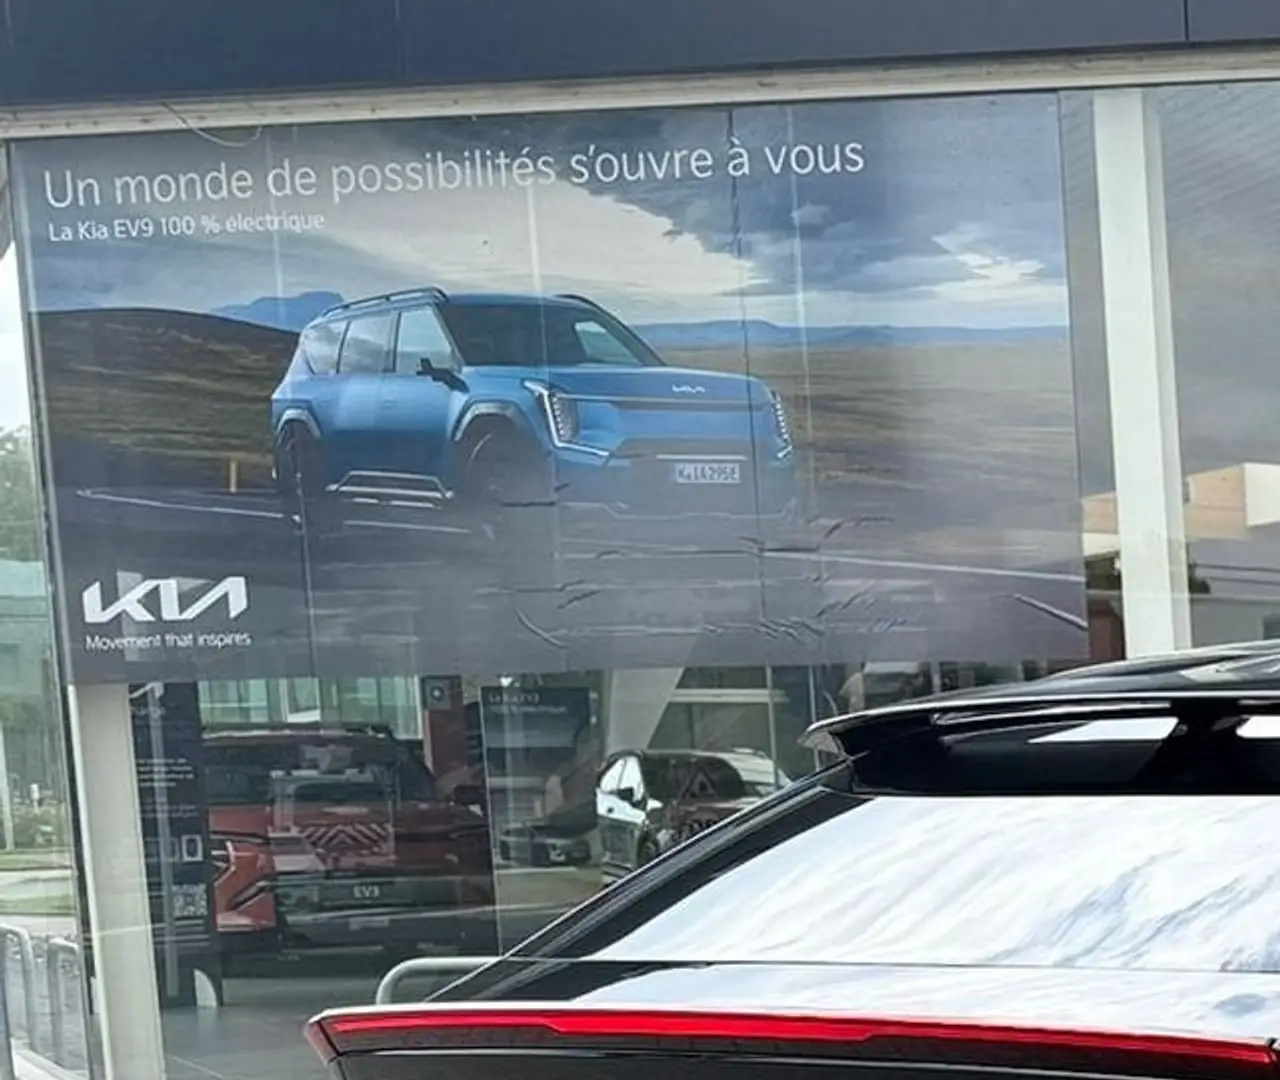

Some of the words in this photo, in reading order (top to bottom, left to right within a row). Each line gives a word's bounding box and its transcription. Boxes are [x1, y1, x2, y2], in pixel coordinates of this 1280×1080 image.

[44, 169, 101, 208] Un
[114, 162, 254, 204] monde
[267, 157, 318, 197] de
[331, 146, 556, 205] possibilités
[570, 144, 714, 185] s'ouvre
[727, 136, 750, 177] à
[765, 140, 865, 174] vous
[49, 223, 73, 241] La
[78, 220, 108, 240] Kia
[113, 218, 153, 238] EV9
[160, 215, 195, 236] 100
[201, 214, 220, 234] %
[82, 575, 248, 623] KIA
[85, 633, 162, 650] Movement
[165, 631, 193, 648] that
[197, 631, 252, 649] inspires
